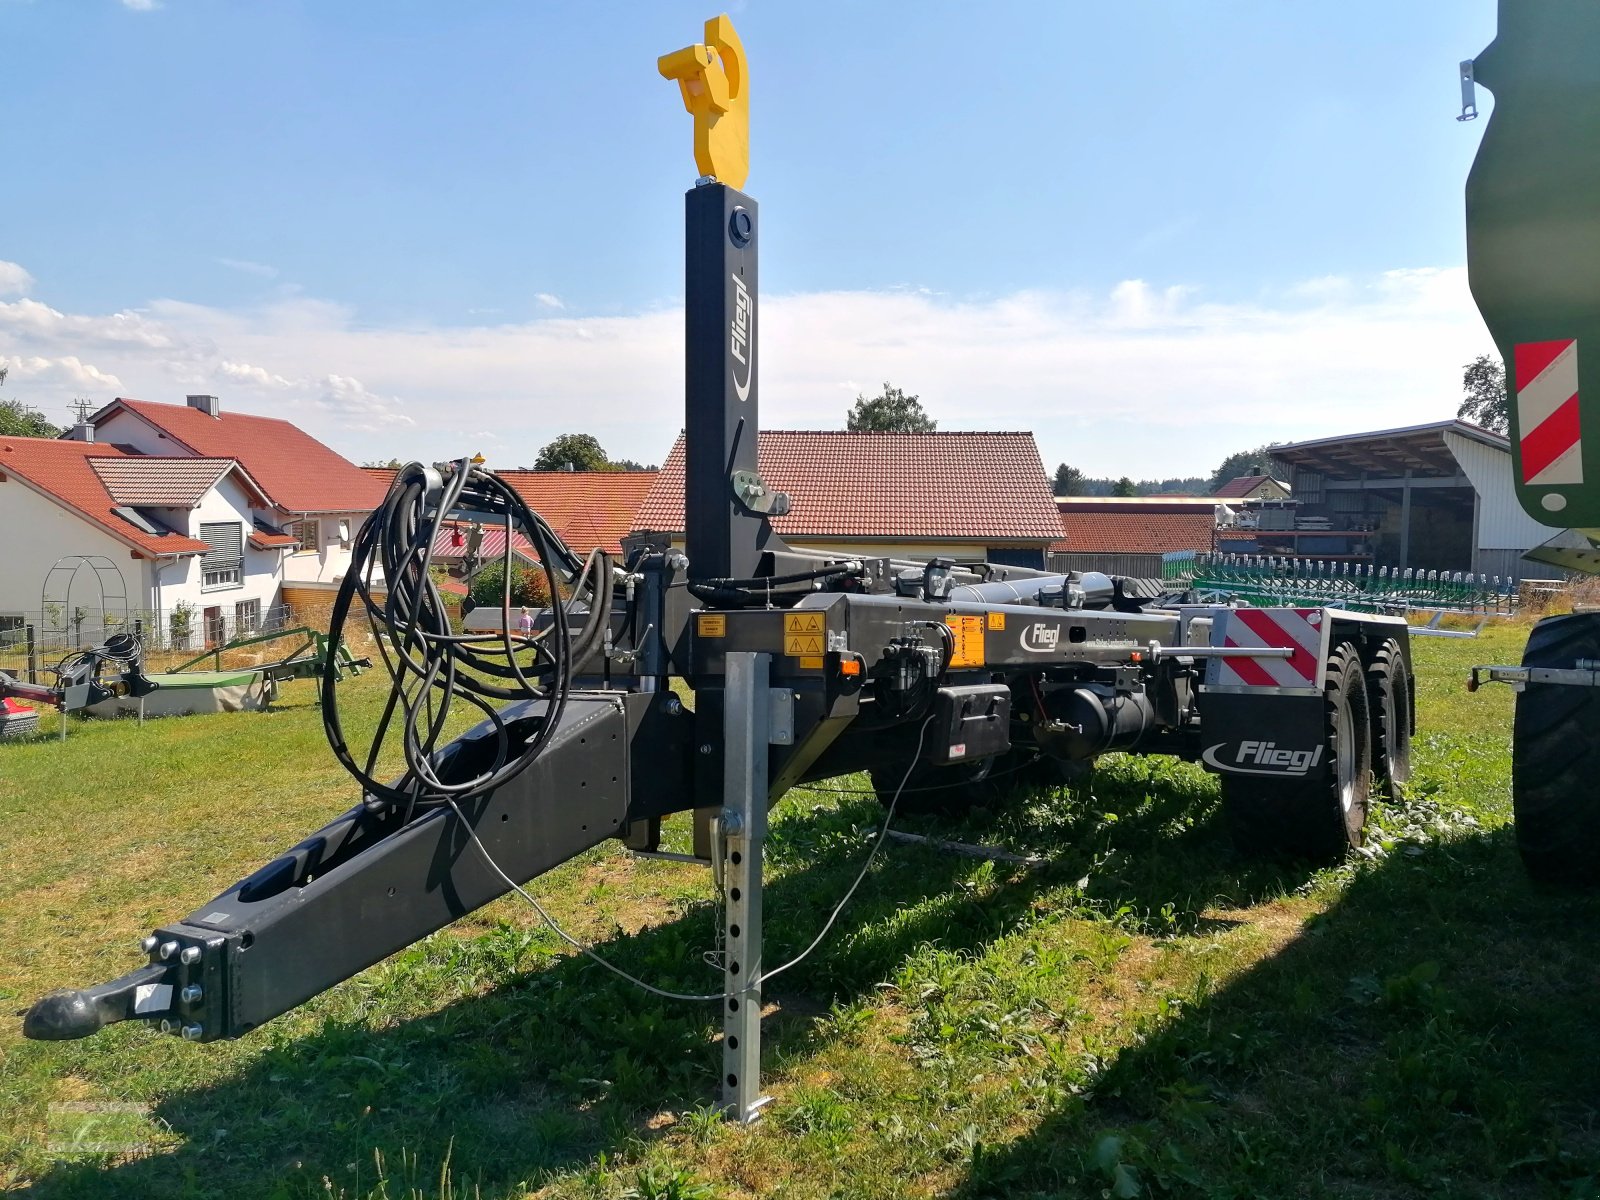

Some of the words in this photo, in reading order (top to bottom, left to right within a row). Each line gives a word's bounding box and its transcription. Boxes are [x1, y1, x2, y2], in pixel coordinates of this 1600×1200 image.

[731, 273, 751, 365] Fliegl
[1032, 623, 1061, 648] Fliegl
[1235, 740, 1324, 772] Fliegl
